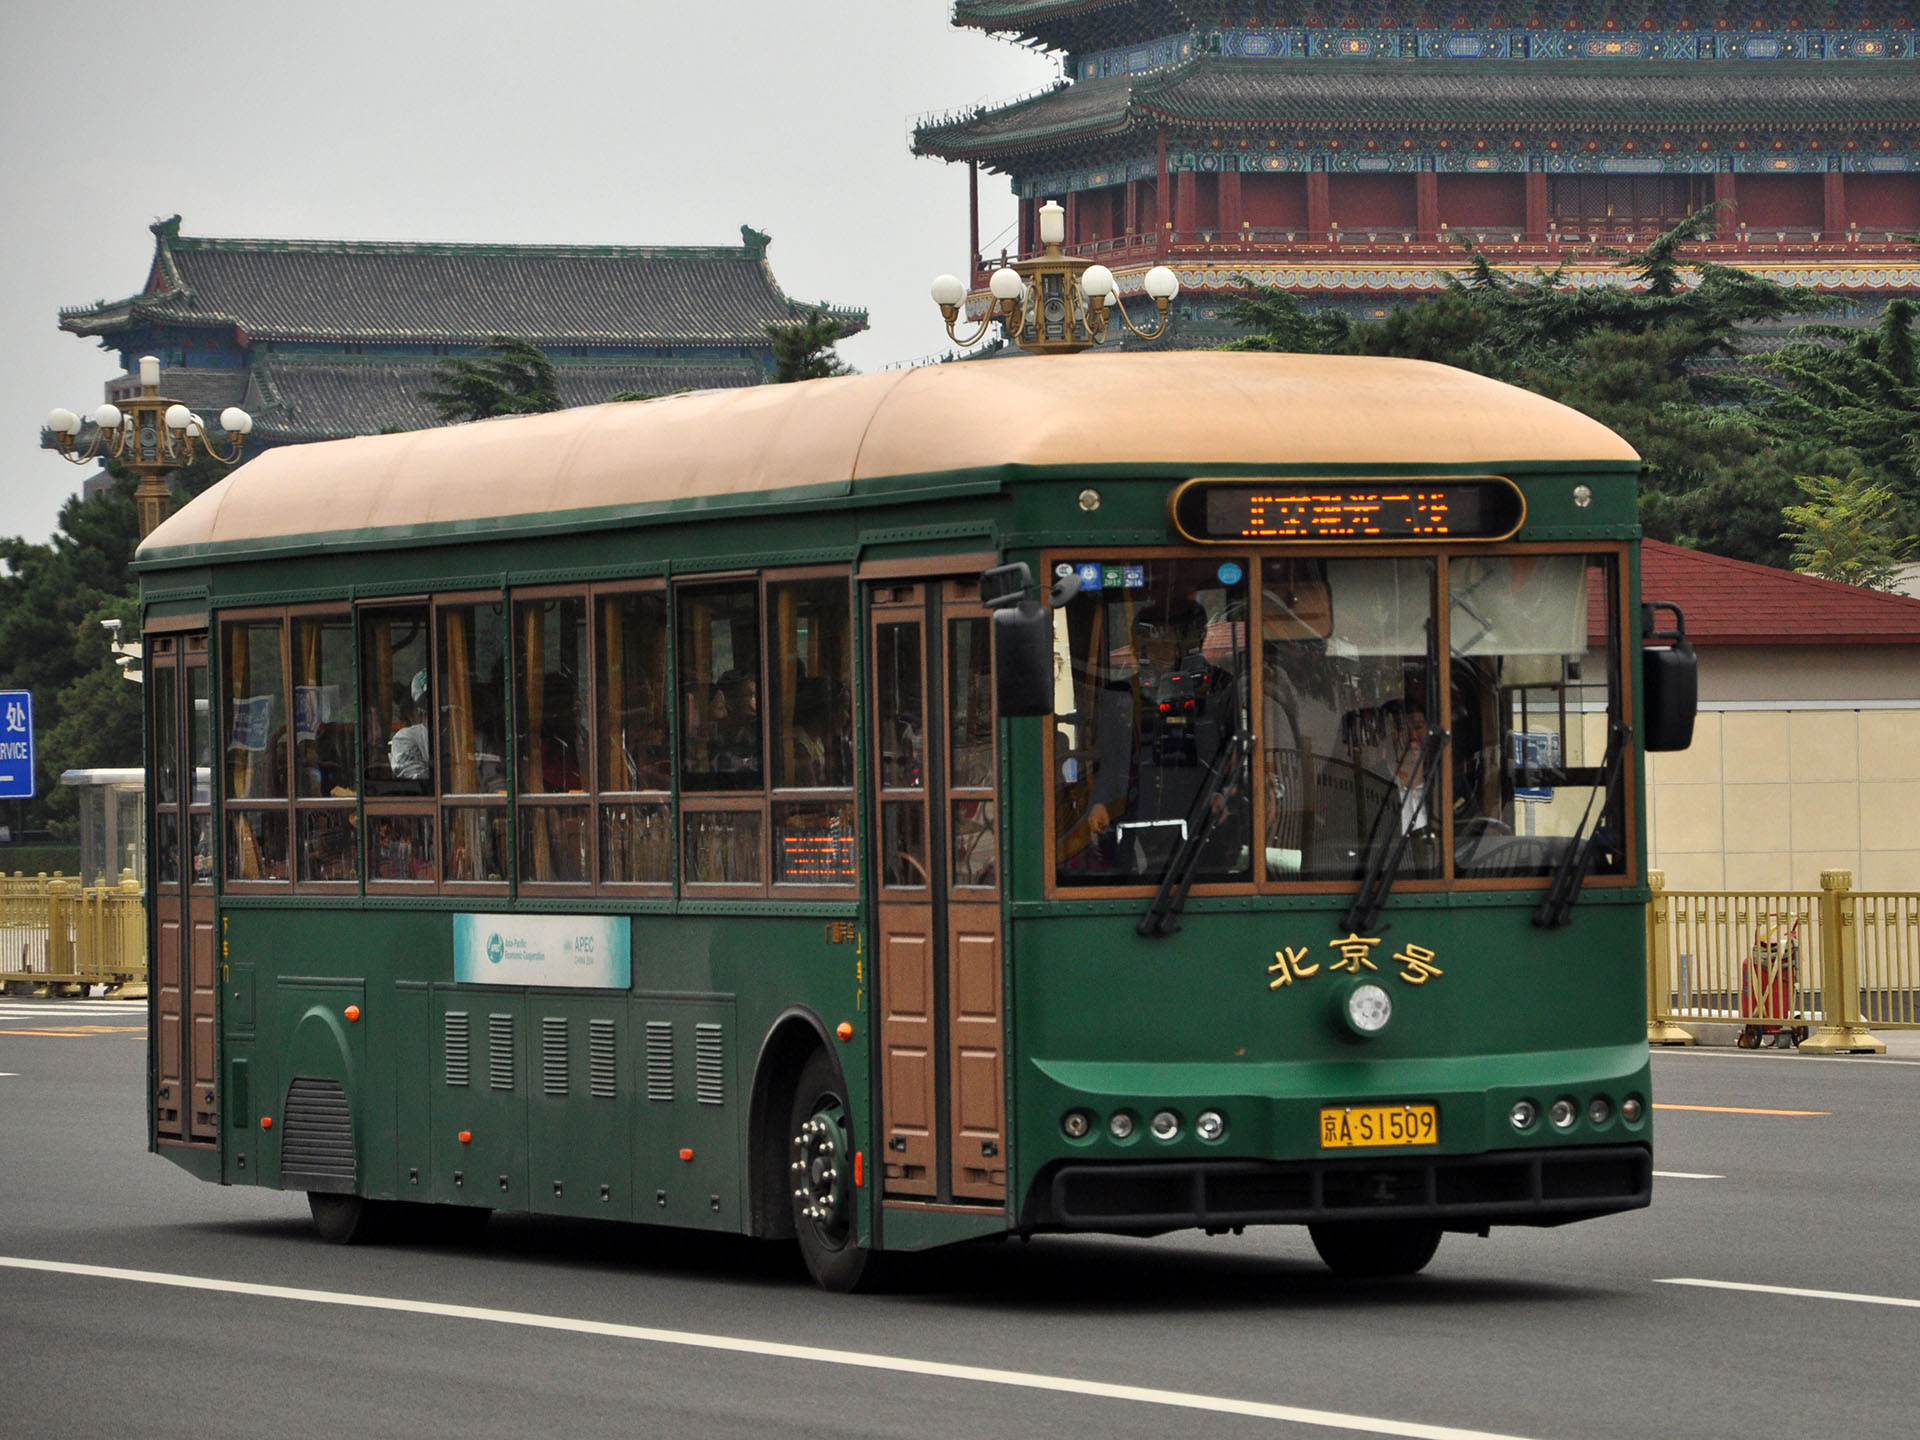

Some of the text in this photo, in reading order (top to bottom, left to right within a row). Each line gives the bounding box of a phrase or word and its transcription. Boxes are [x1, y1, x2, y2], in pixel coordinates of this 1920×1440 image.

[6, 701, 26, 733] 处
[575, 936, 594, 952] APEC
[1267, 932, 1444, 991] 北京号
